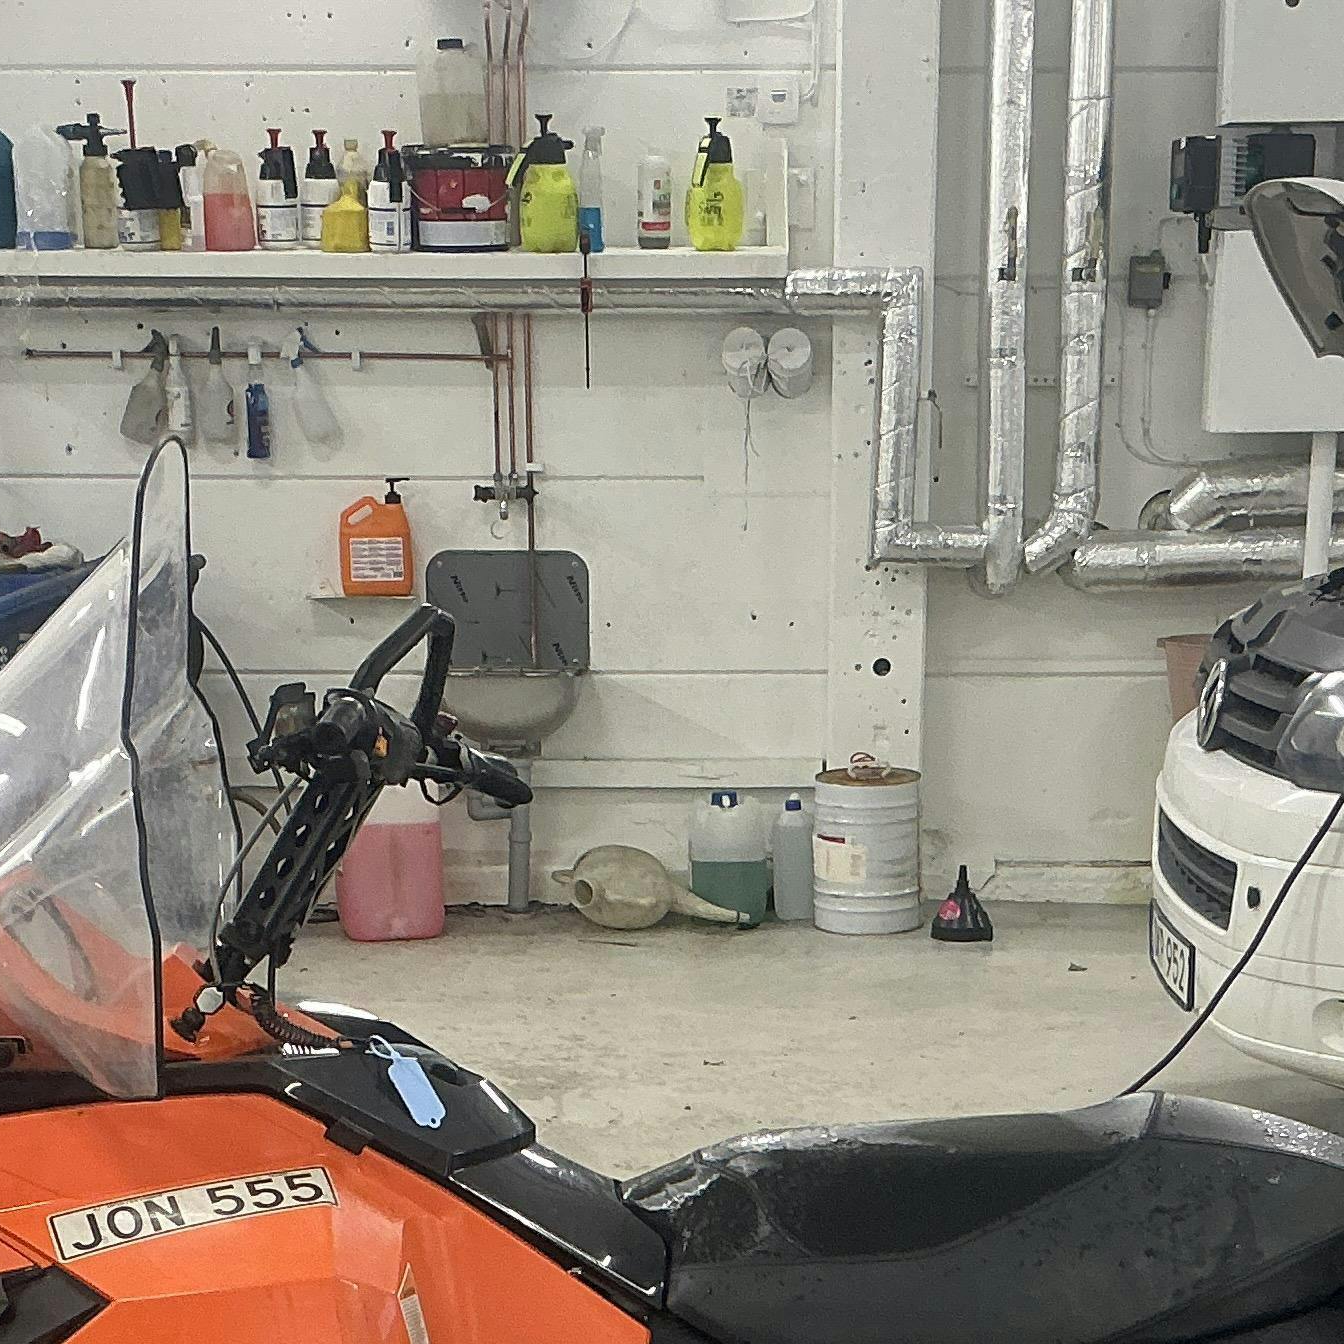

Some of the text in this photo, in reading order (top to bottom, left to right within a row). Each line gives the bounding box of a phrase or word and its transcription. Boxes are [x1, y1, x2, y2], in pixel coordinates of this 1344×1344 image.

[1166, 937, 1184, 992] 952
[72, 1173, 324, 1251] JON 555
